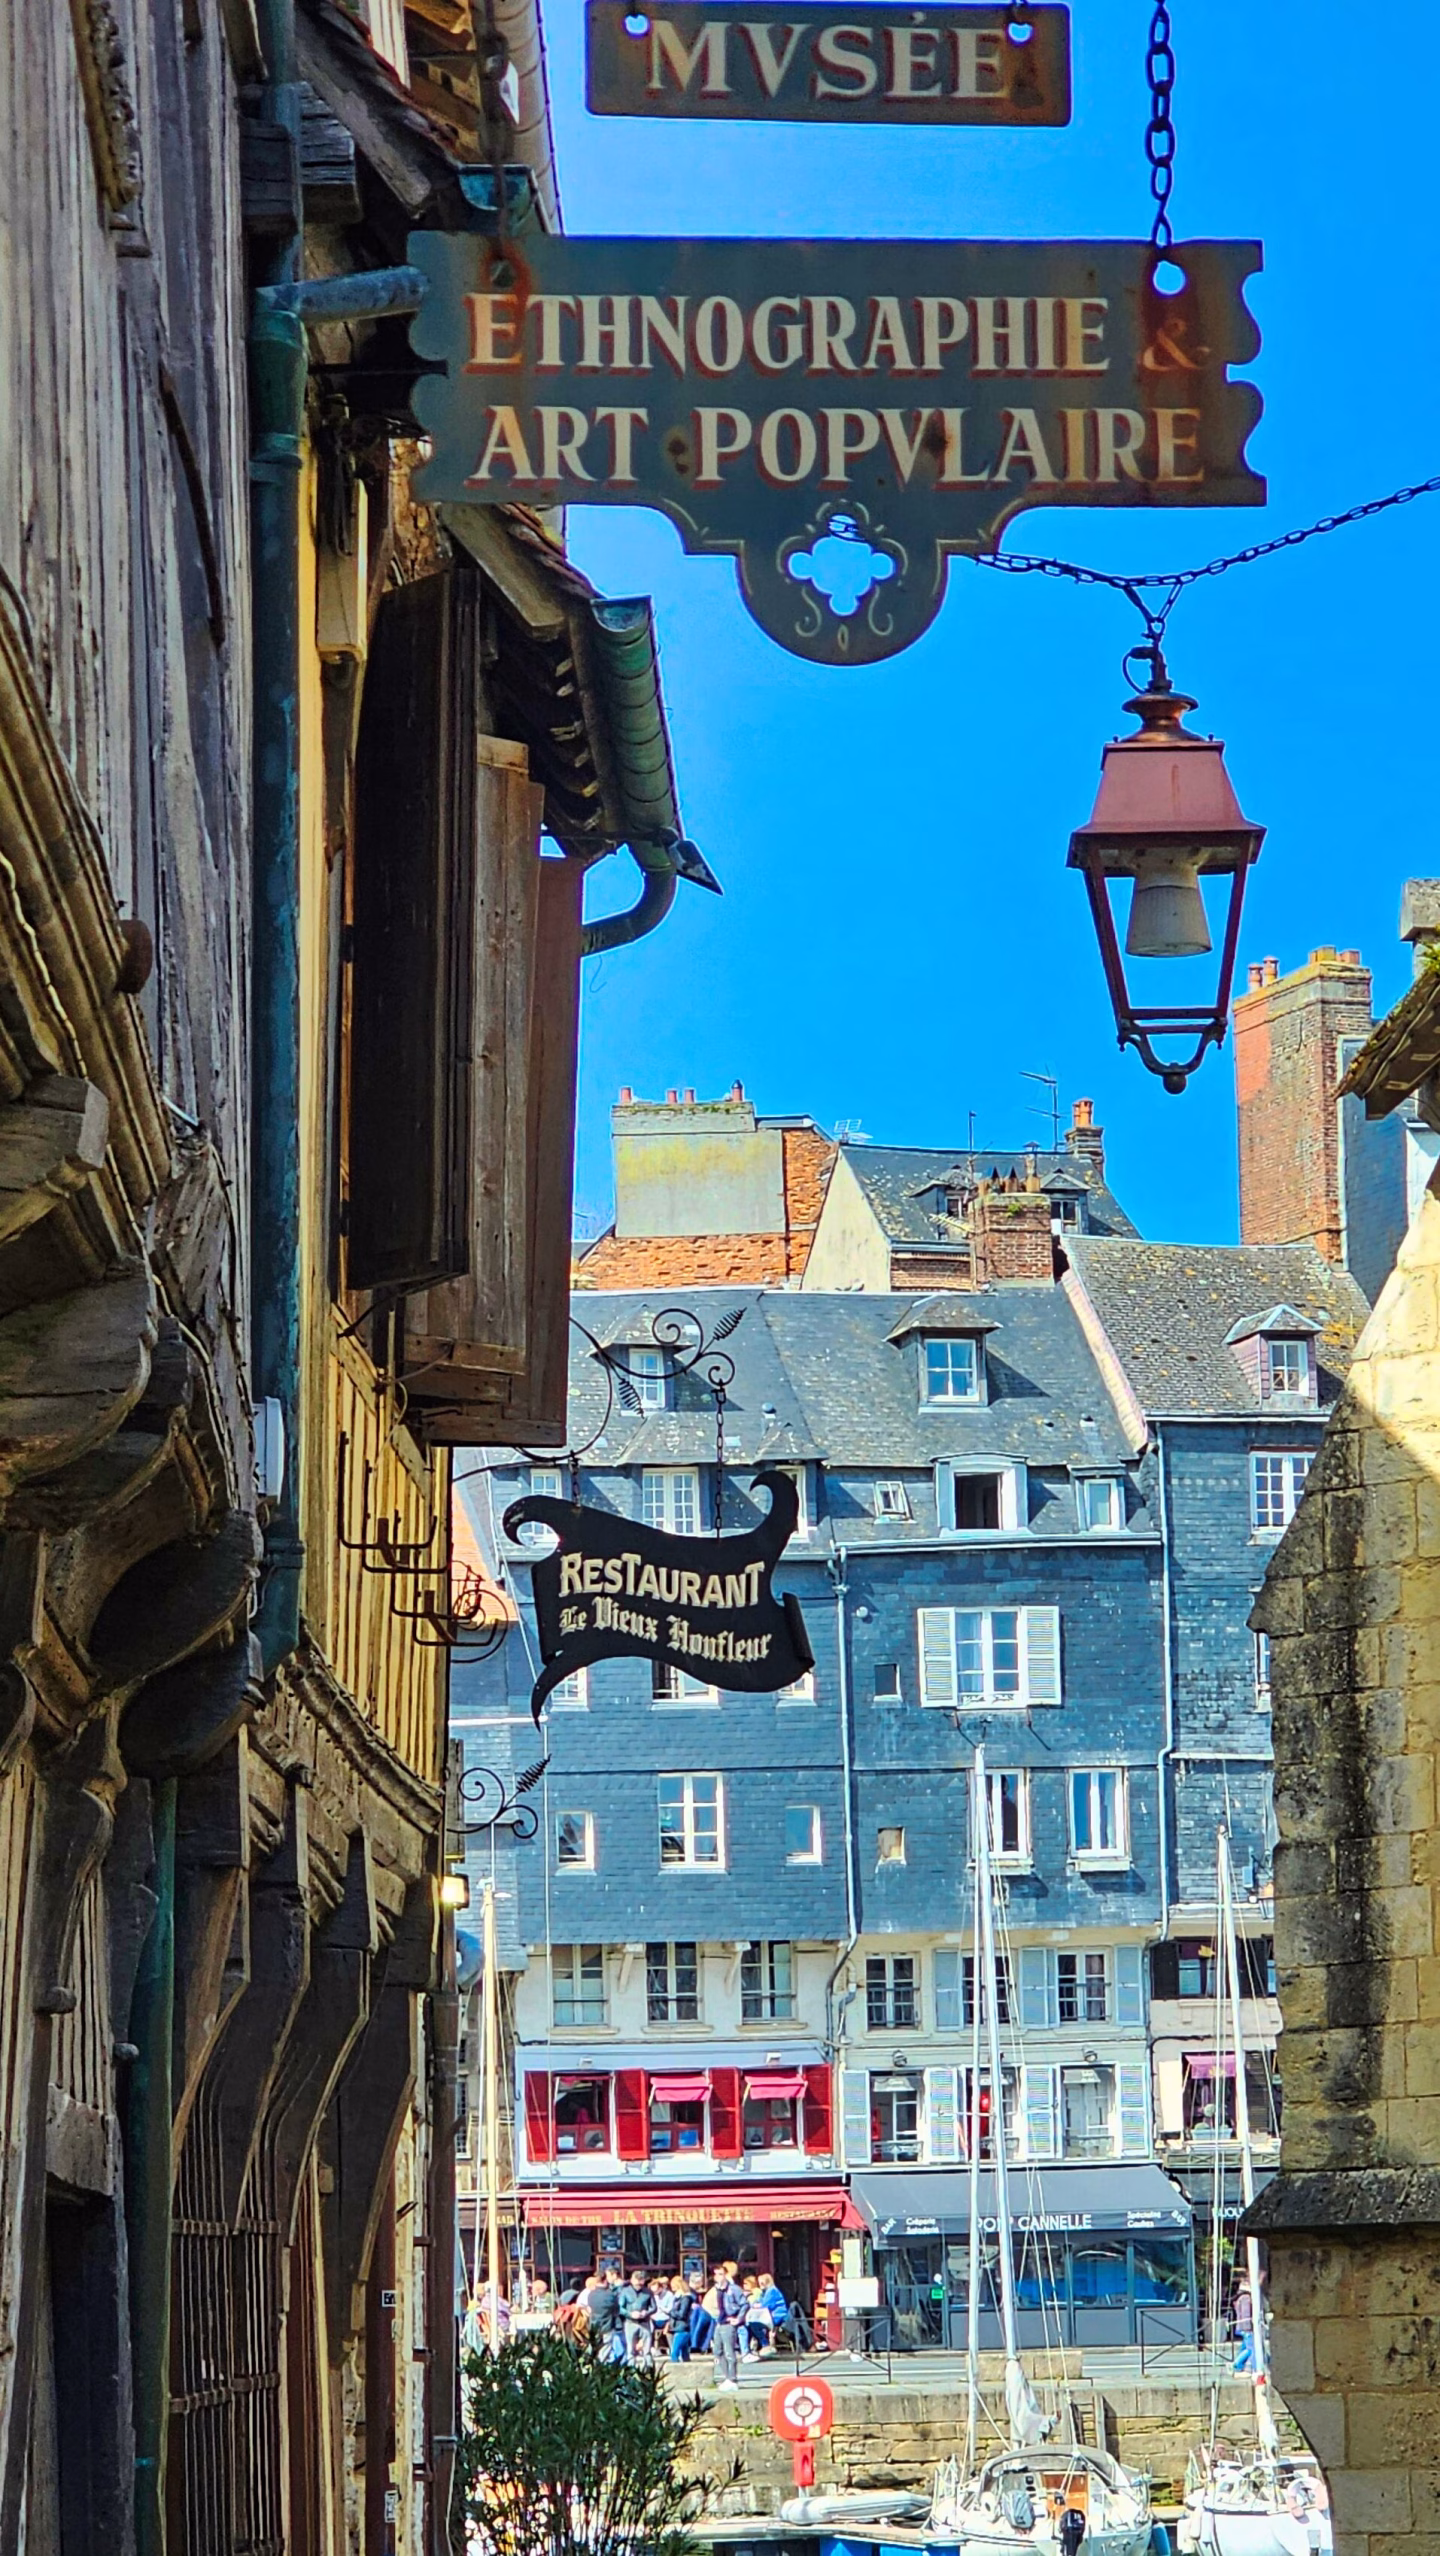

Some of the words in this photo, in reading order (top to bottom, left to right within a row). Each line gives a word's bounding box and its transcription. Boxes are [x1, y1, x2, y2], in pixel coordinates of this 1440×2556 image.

[464, 291, 1111, 376] ETHNOGRAPHIE
[1142, 317, 1212, 373] &
[465, 404, 651, 486] ART
[692, 406, 1205, 488] POPVLAIRE
[559, 1605, 588, 1636] Le
[591, 1595, 659, 1643] Vieux
[666, 1614, 773, 1664] Honfleur
[612, 2209, 638, 2225] LA
[880, 2217, 898, 2235] BAR
[1017, 2213, 1094, 2232] CANNELLE
